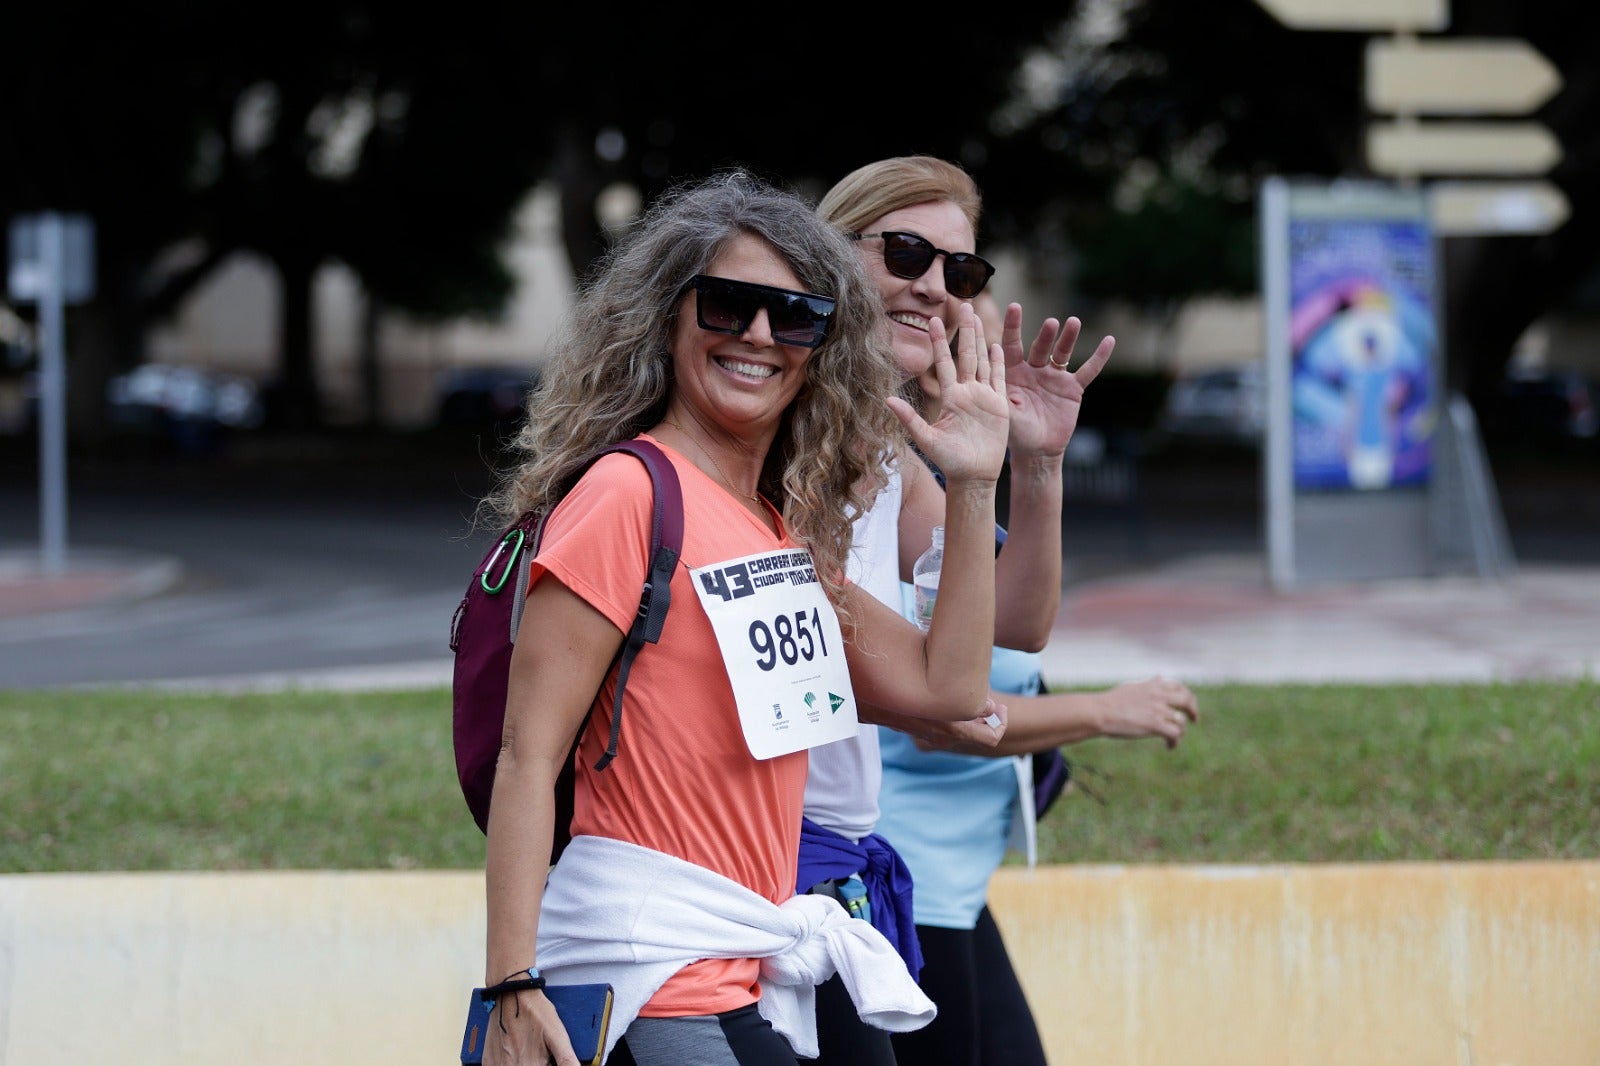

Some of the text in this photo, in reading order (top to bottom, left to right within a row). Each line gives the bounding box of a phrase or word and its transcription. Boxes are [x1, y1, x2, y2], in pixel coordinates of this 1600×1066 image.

[748, 554, 790, 574] CARRERA
[753, 572, 785, 588] CIUDAD
[788, 568, 819, 586] MÁLAG
[700, 563, 755, 602] 43
[748, 607, 828, 672] 9851
